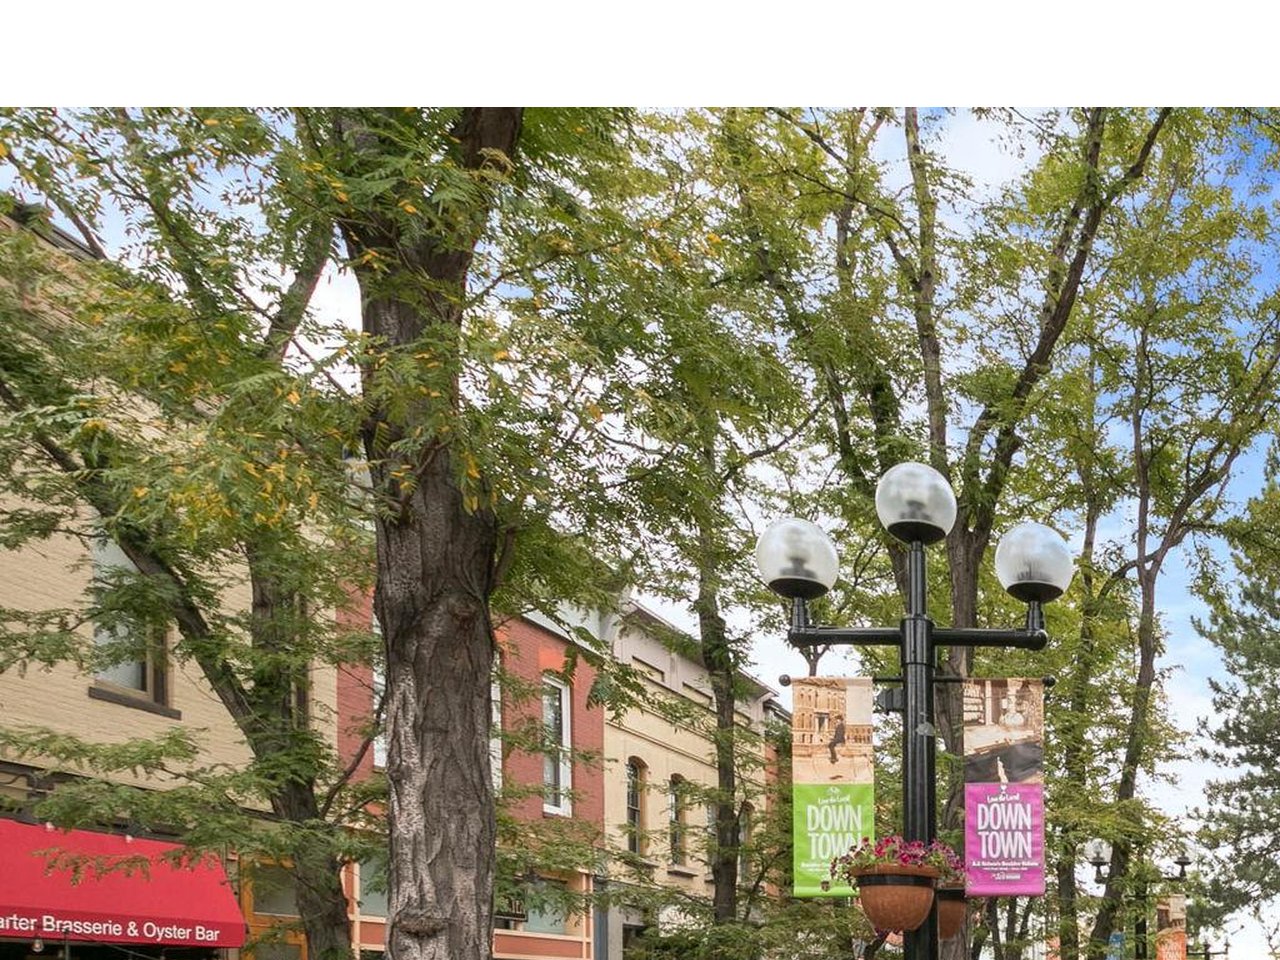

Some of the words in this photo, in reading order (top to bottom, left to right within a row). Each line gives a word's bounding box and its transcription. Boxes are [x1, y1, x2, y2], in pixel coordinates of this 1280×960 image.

[806, 804, 862, 832] DOWN
[977, 803, 1032, 830] DOWN
[977, 831, 1032, 859] TOWN
[42, 915, 122, 936] Brasserie
[128, 921, 139, 937] &
[143, 922, 192, 942] Oyster
[195, 926, 220, 941] Bar
